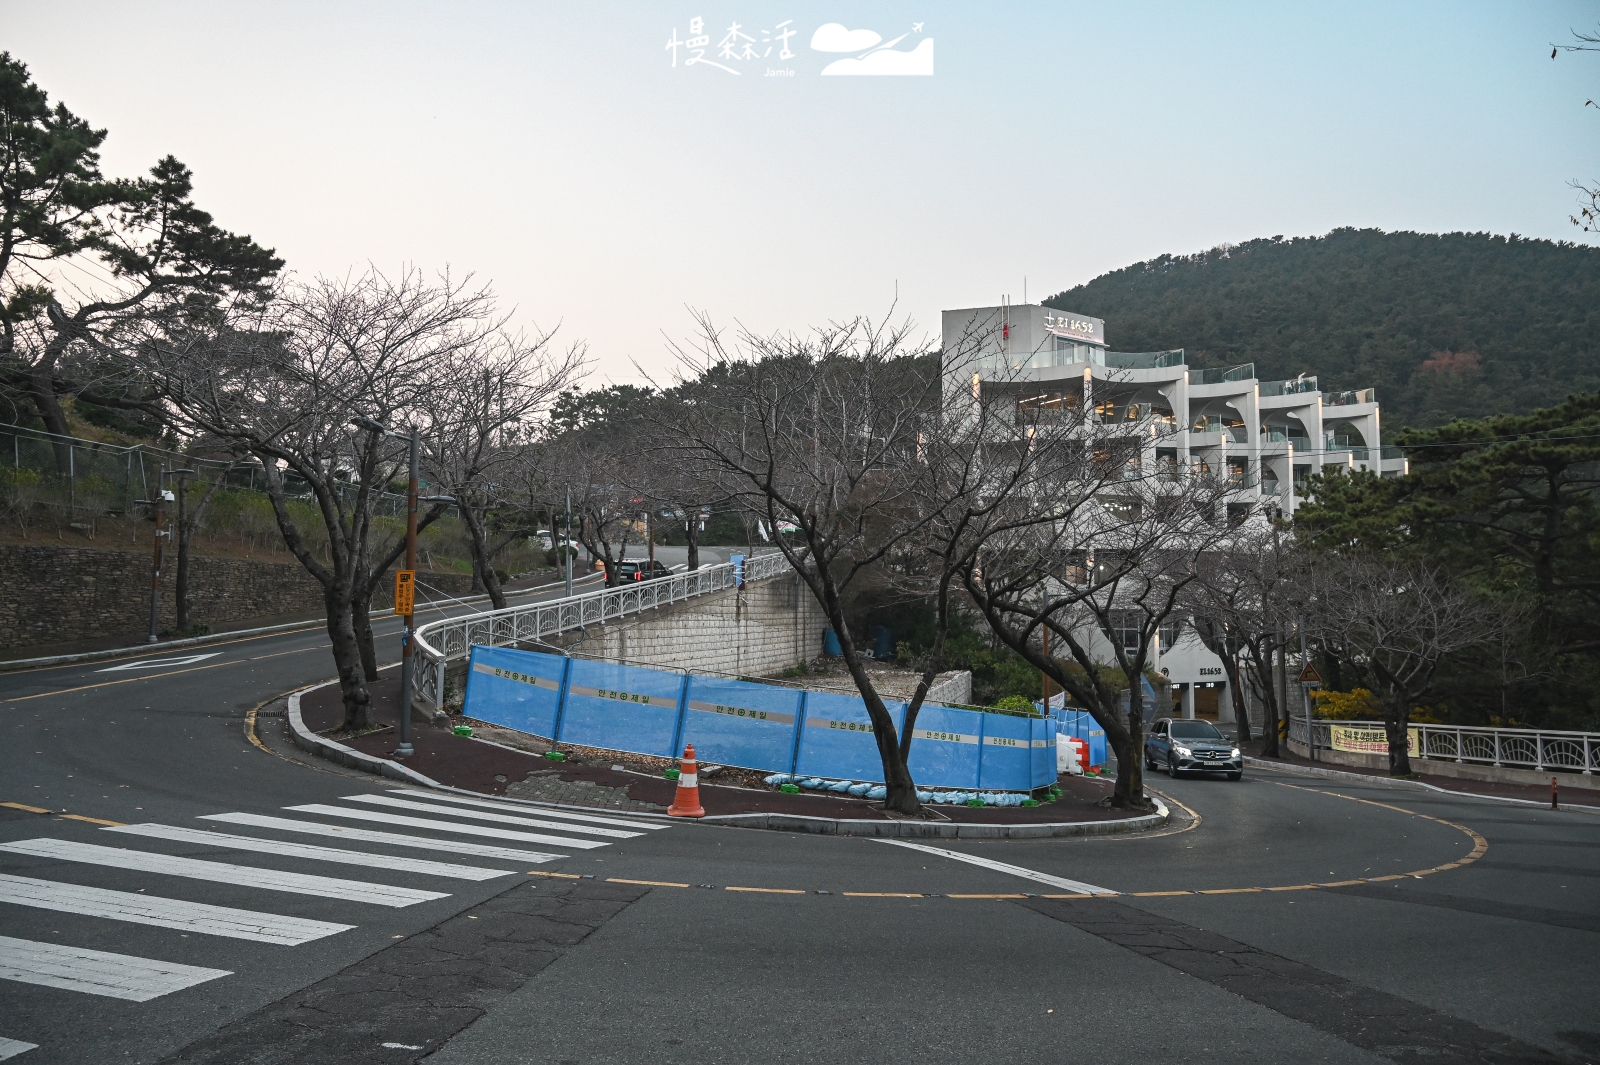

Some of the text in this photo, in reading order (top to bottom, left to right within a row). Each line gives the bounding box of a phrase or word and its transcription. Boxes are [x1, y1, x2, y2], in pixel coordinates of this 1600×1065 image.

[494, 667, 537, 685] 안전 제일
[598, 689, 650, 704] 안전 제일
[715, 704, 768, 721] 안전 제일
[829, 719, 847, 730] 안전
